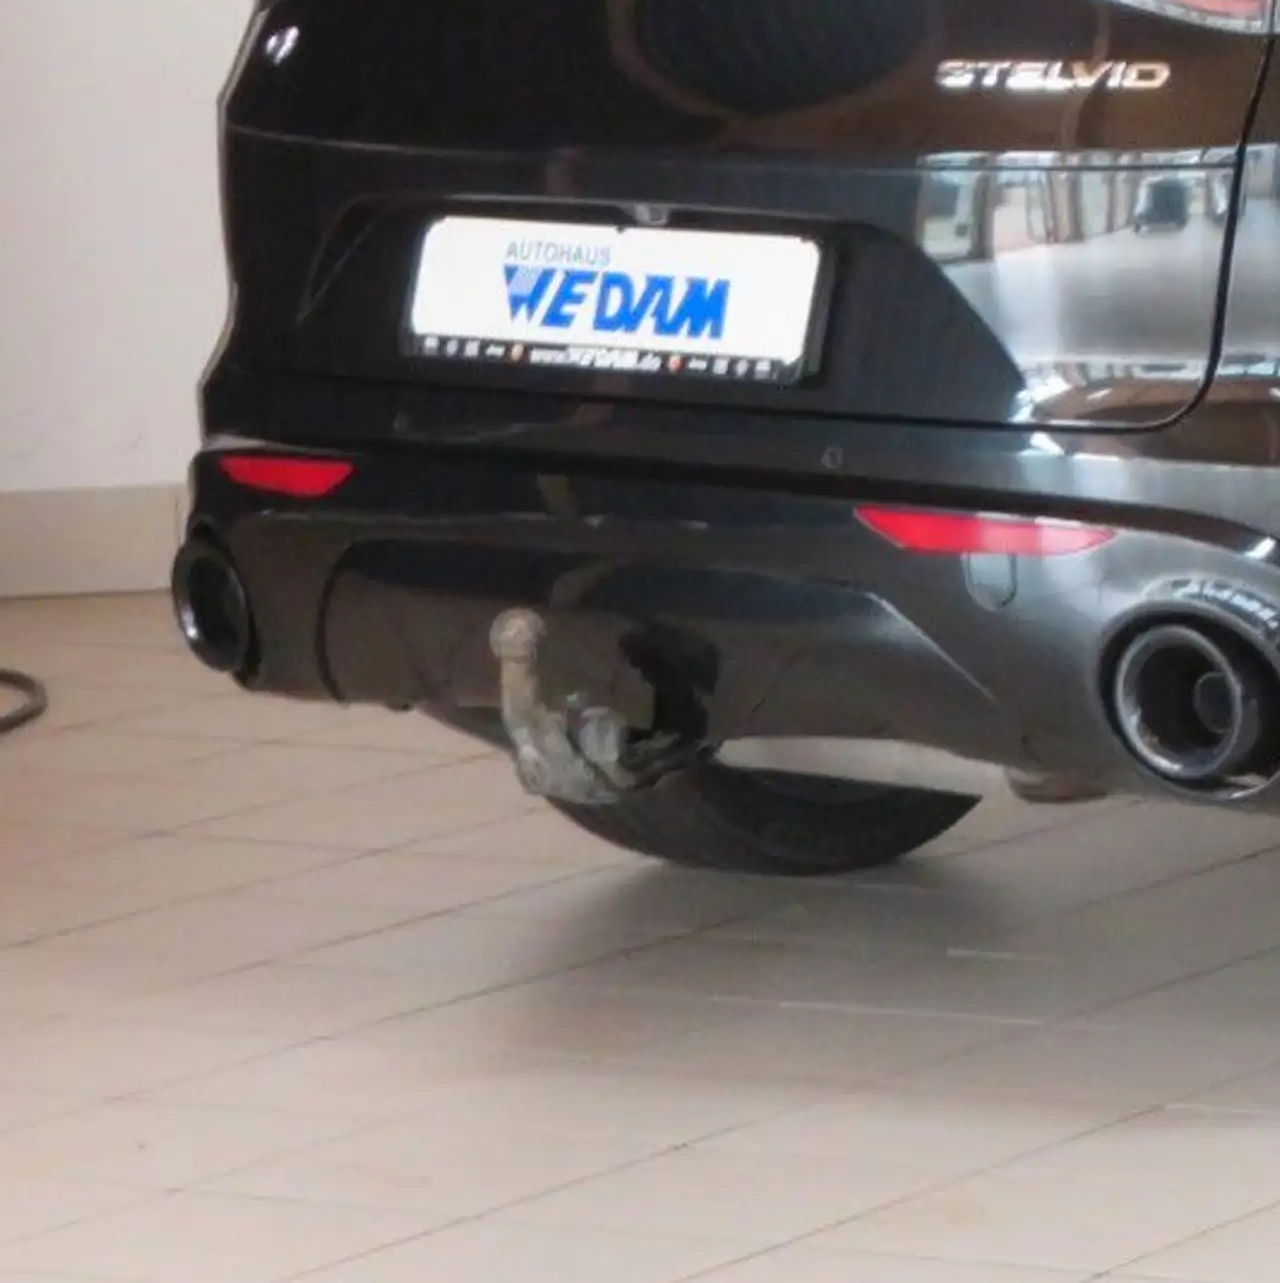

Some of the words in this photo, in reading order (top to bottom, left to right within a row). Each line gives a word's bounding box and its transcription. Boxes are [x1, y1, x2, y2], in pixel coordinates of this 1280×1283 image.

[934, 58, 1171, 89] STELVIO
[505, 240, 611, 267] AUTOHAUS
[503, 263, 731, 340] WEDAM
